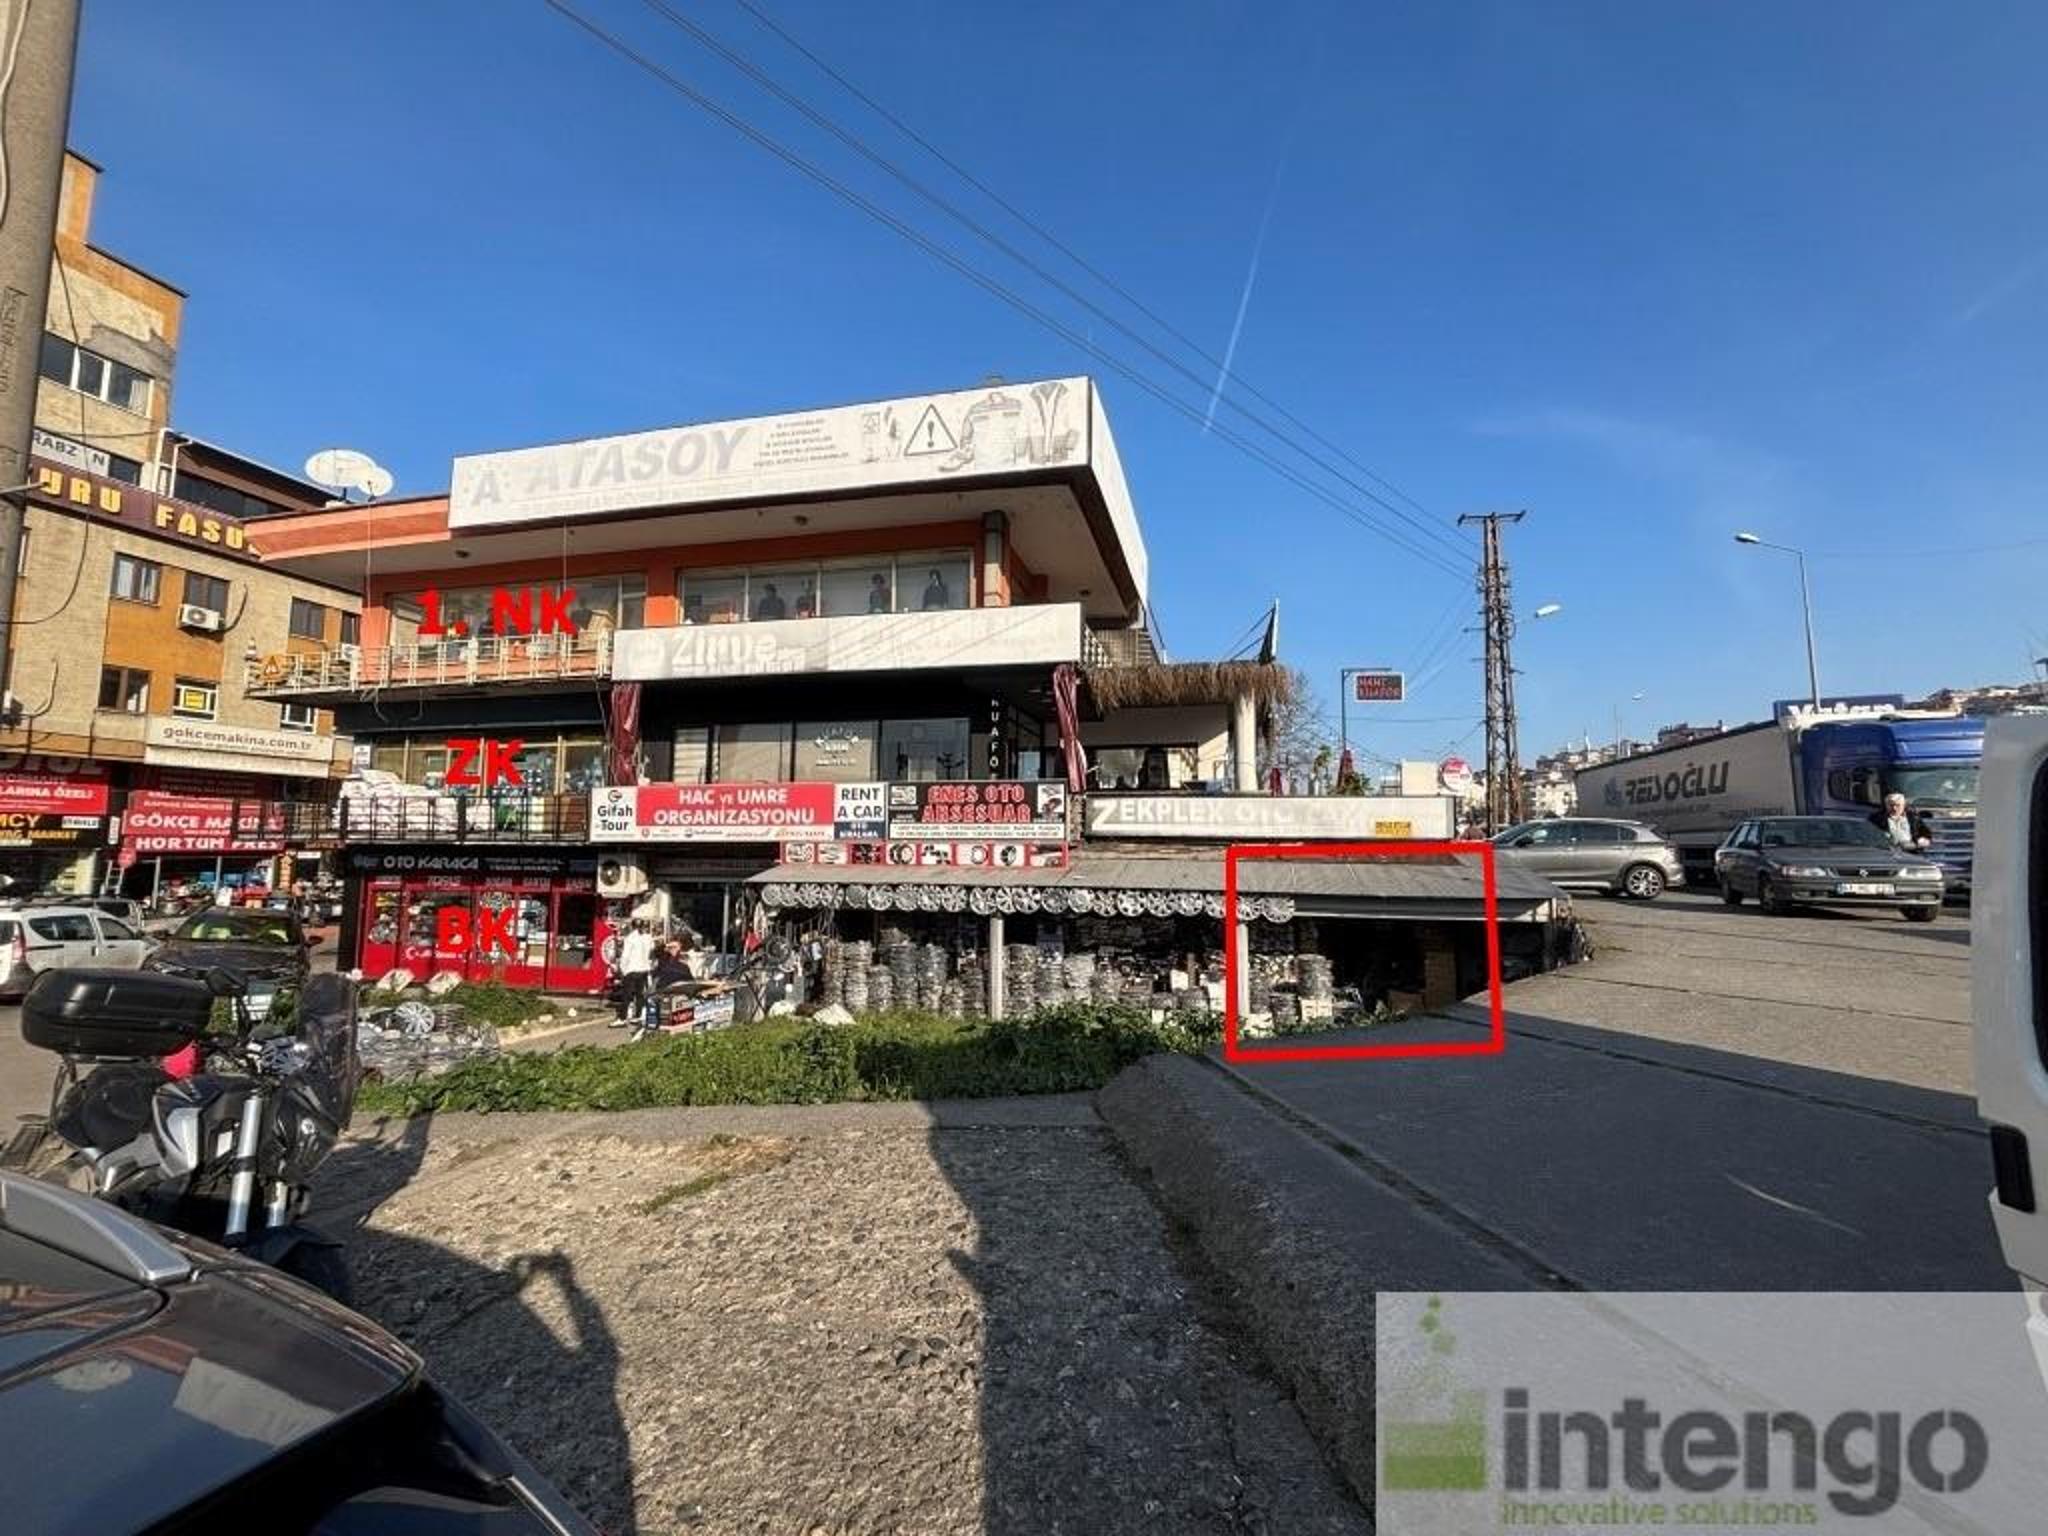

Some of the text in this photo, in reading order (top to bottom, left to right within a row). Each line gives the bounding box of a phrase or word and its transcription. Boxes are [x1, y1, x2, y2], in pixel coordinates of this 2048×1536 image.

[526, 425, 750, 494] ATASOY
[679, 789, 715, 805] HAC
[737, 787, 788, 804] UMRE
[841, 787, 881, 801] RENT
[927, 784, 1026, 803] ENES OTO
[597, 804, 634, 818] Gifah
[654, 804, 816, 826] ORGANİZASYONU
[837, 805, 849, 819] A
[852, 805, 883, 819] CAR
[920, 803, 1032, 824] AKSESUAR
[129, 811, 200, 830] GÖKÇE
[135, 836, 226, 850] HORTUM
[383, 856, 416, 869] OTO
[417, 856, 480, 870] KARACA
